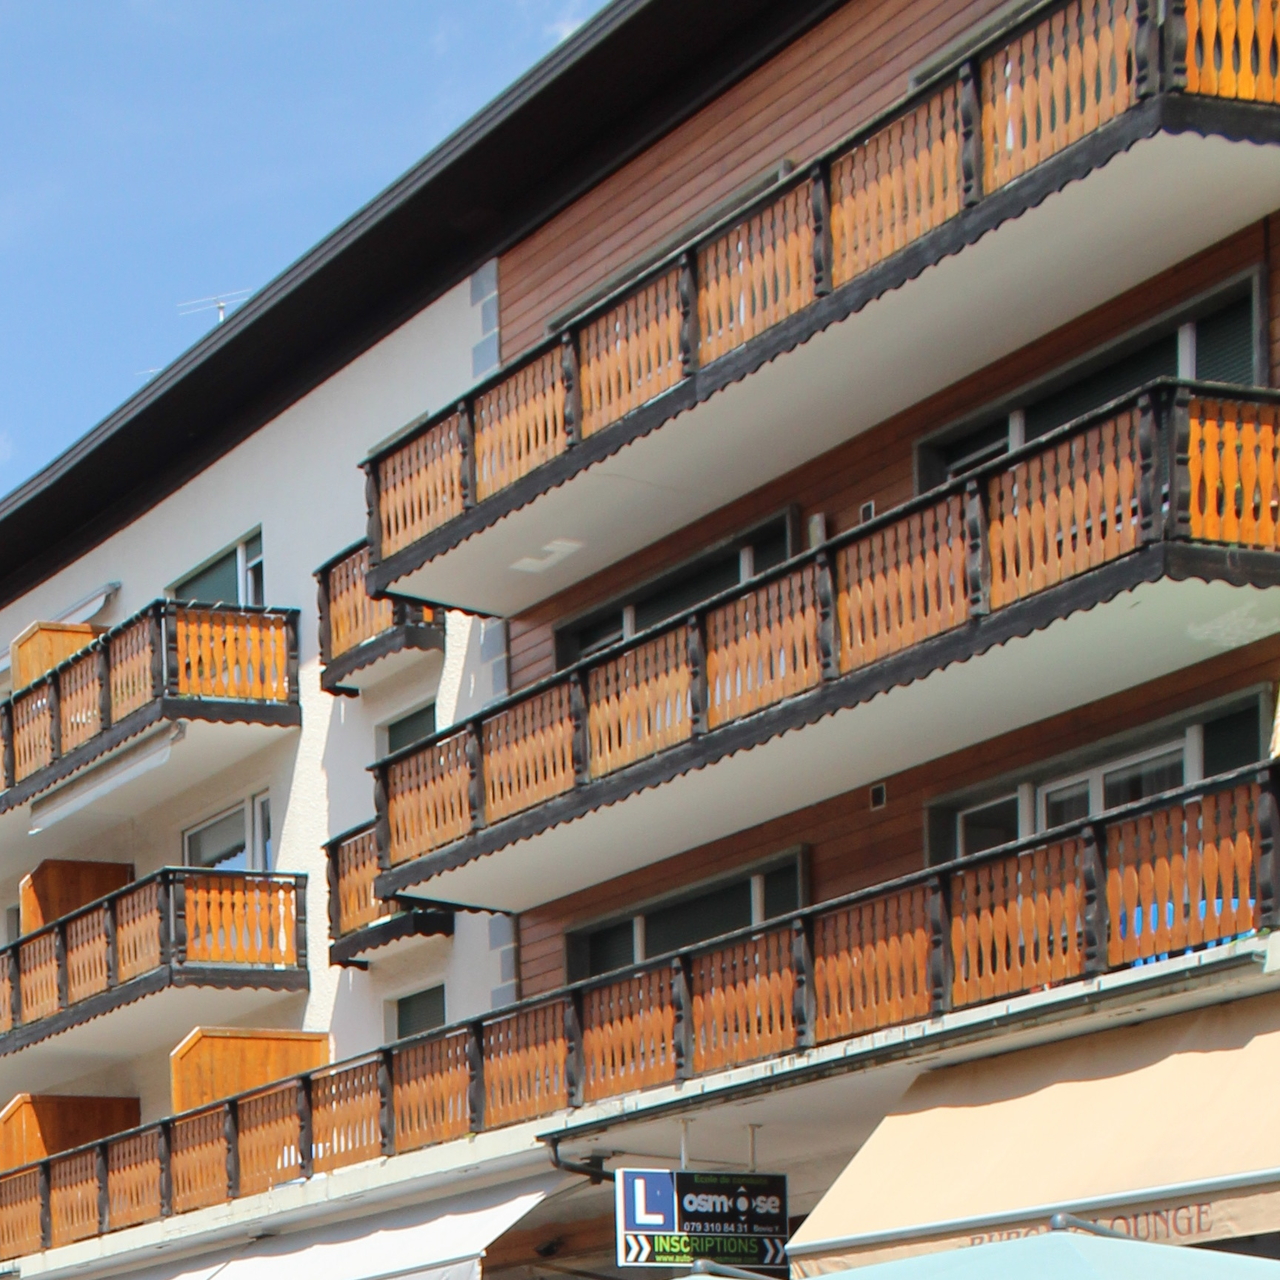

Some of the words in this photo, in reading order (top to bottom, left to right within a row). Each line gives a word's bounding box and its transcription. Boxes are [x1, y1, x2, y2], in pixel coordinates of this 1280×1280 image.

[634, 1177, 664, 1225] L
[683, 1221, 702, 1232] 079
[704, 1222, 722, 1232] 310
[723, 1223, 735, 1232] 84
[737, 1223, 748, 1233] 31
[1090, 1202, 1212, 1243] OUNGE
[654, 1235, 759, 1252] INSCRIPTIONS
